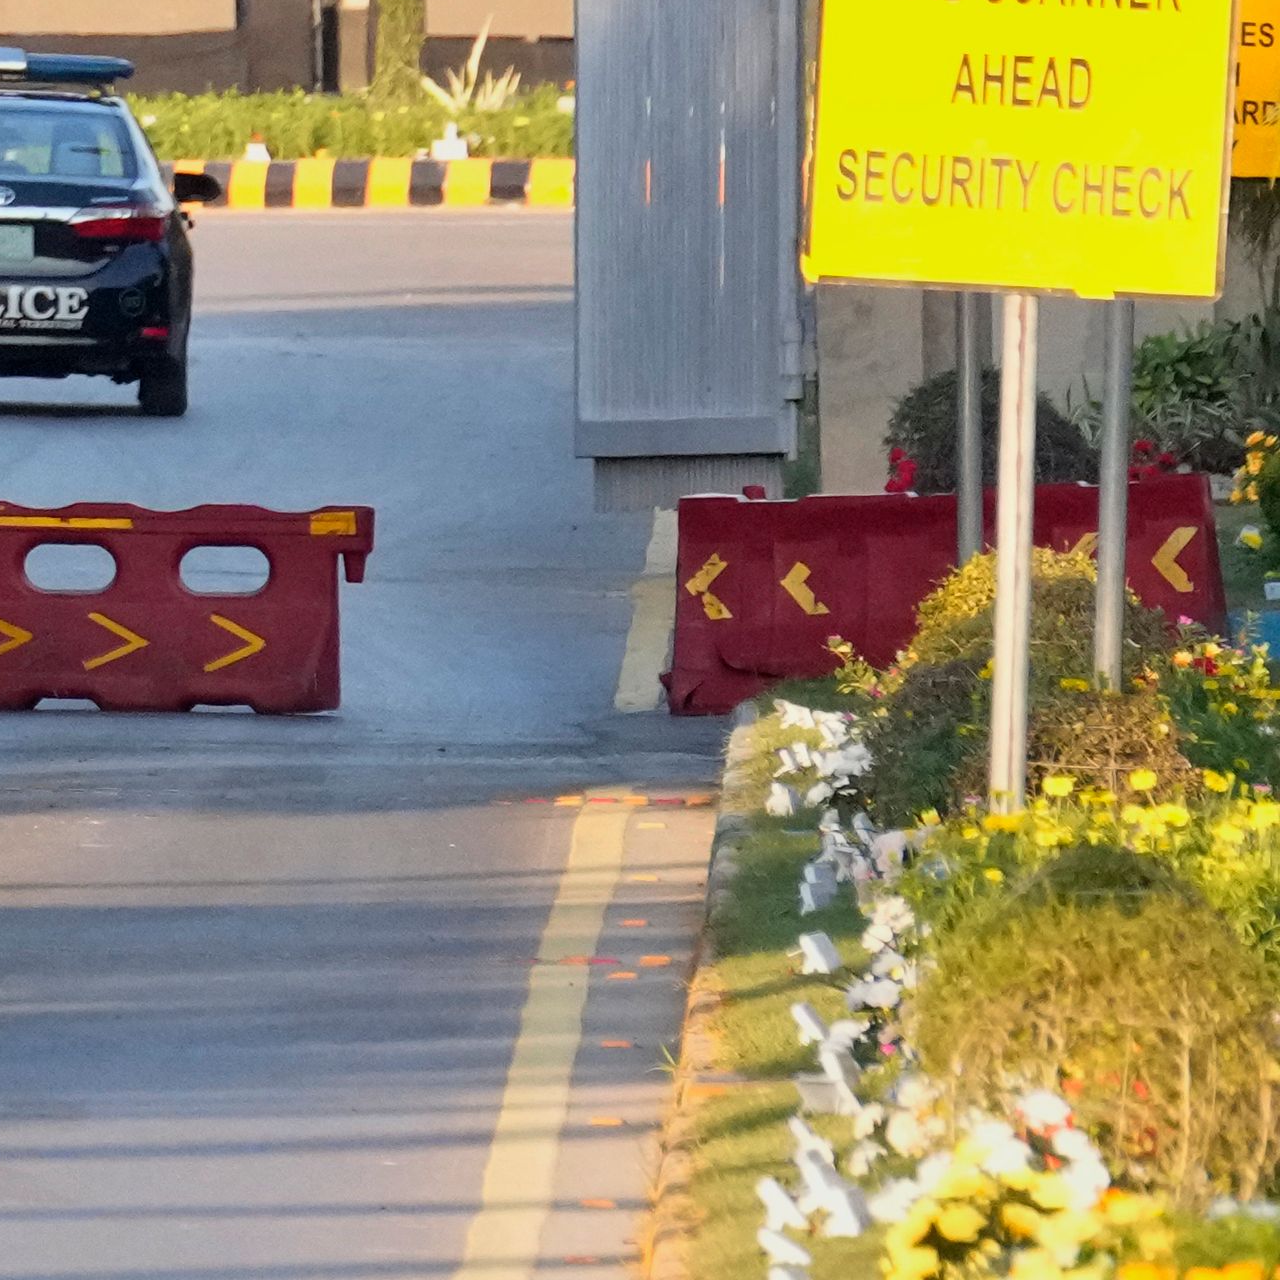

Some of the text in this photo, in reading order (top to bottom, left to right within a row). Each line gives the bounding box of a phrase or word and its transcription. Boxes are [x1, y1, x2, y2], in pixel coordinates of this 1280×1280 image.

[951, 53, 1092, 110] AHEAD
[836, 148, 1194, 221] SECURITY CHECK
